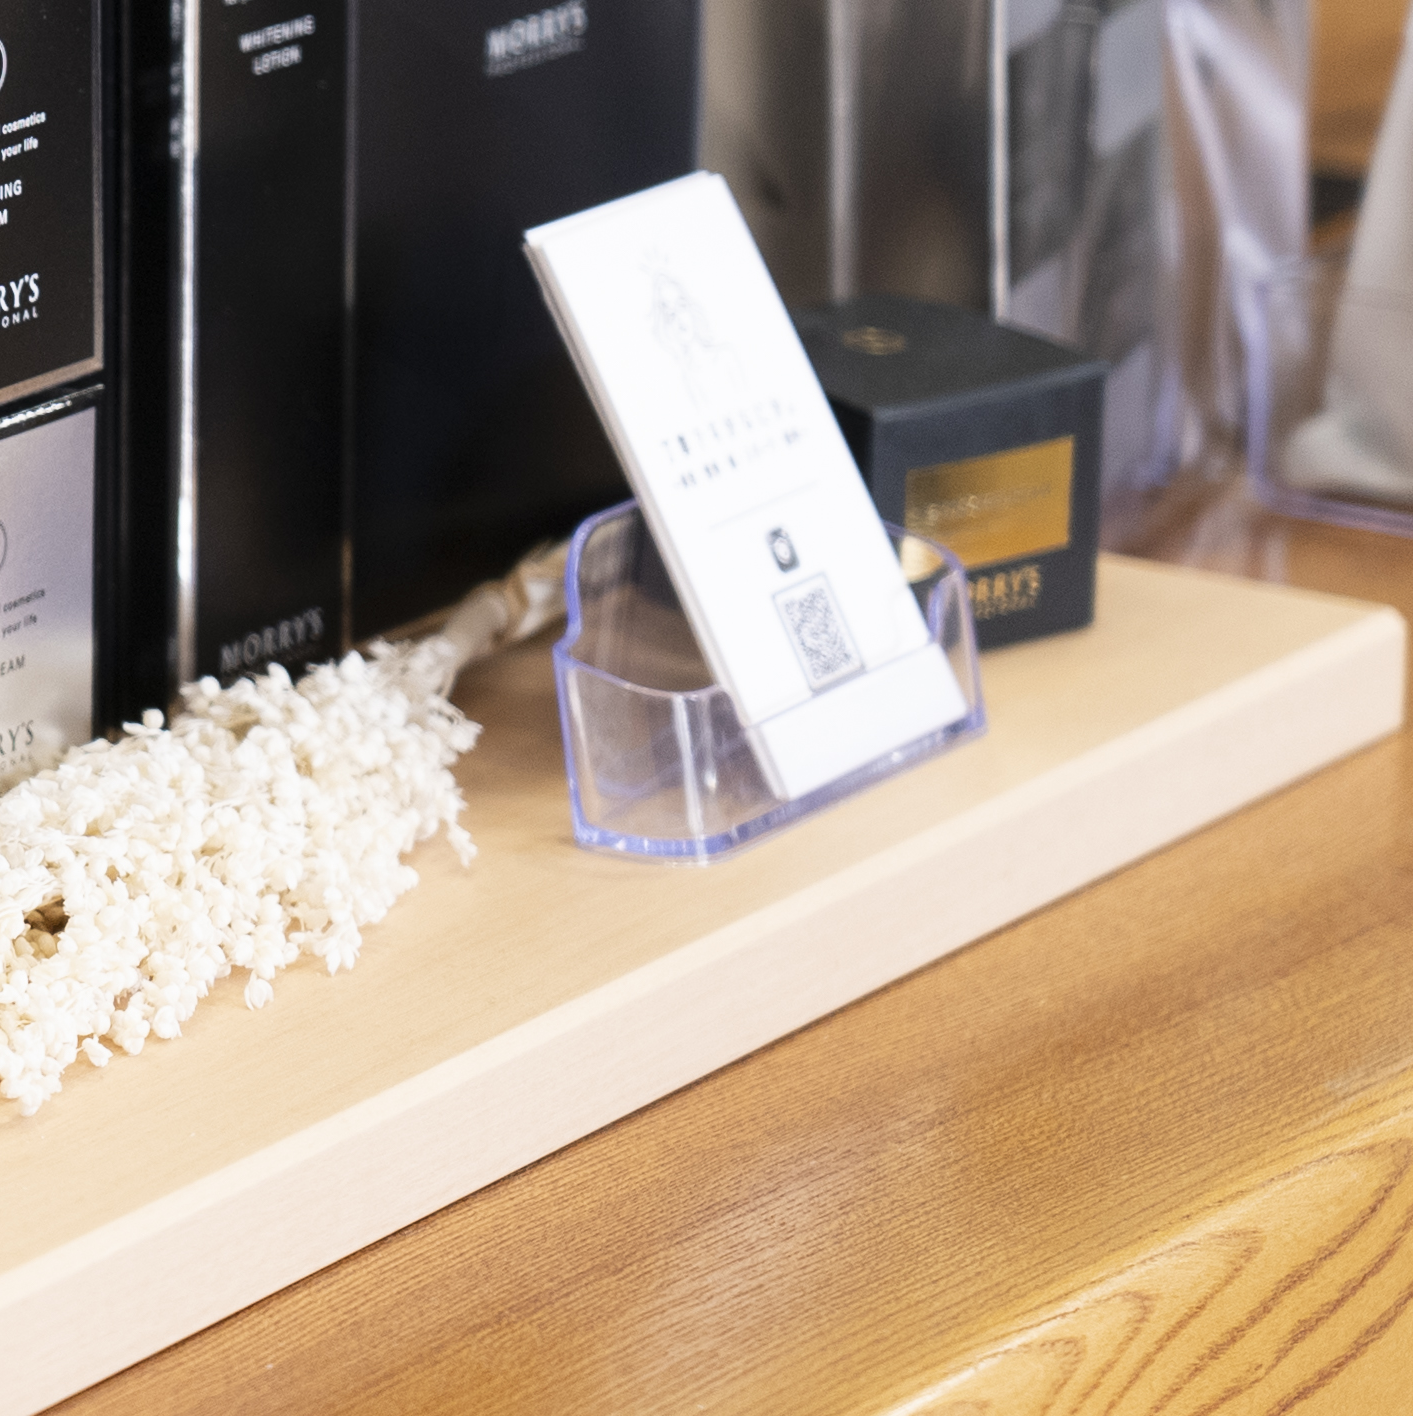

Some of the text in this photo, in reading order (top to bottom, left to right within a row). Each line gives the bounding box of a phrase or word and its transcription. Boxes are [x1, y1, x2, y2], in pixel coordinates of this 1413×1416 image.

[2, 112, 46, 134] cosmetics
[1, 144, 22, 161] your
[24, 137, 38, 151] life
